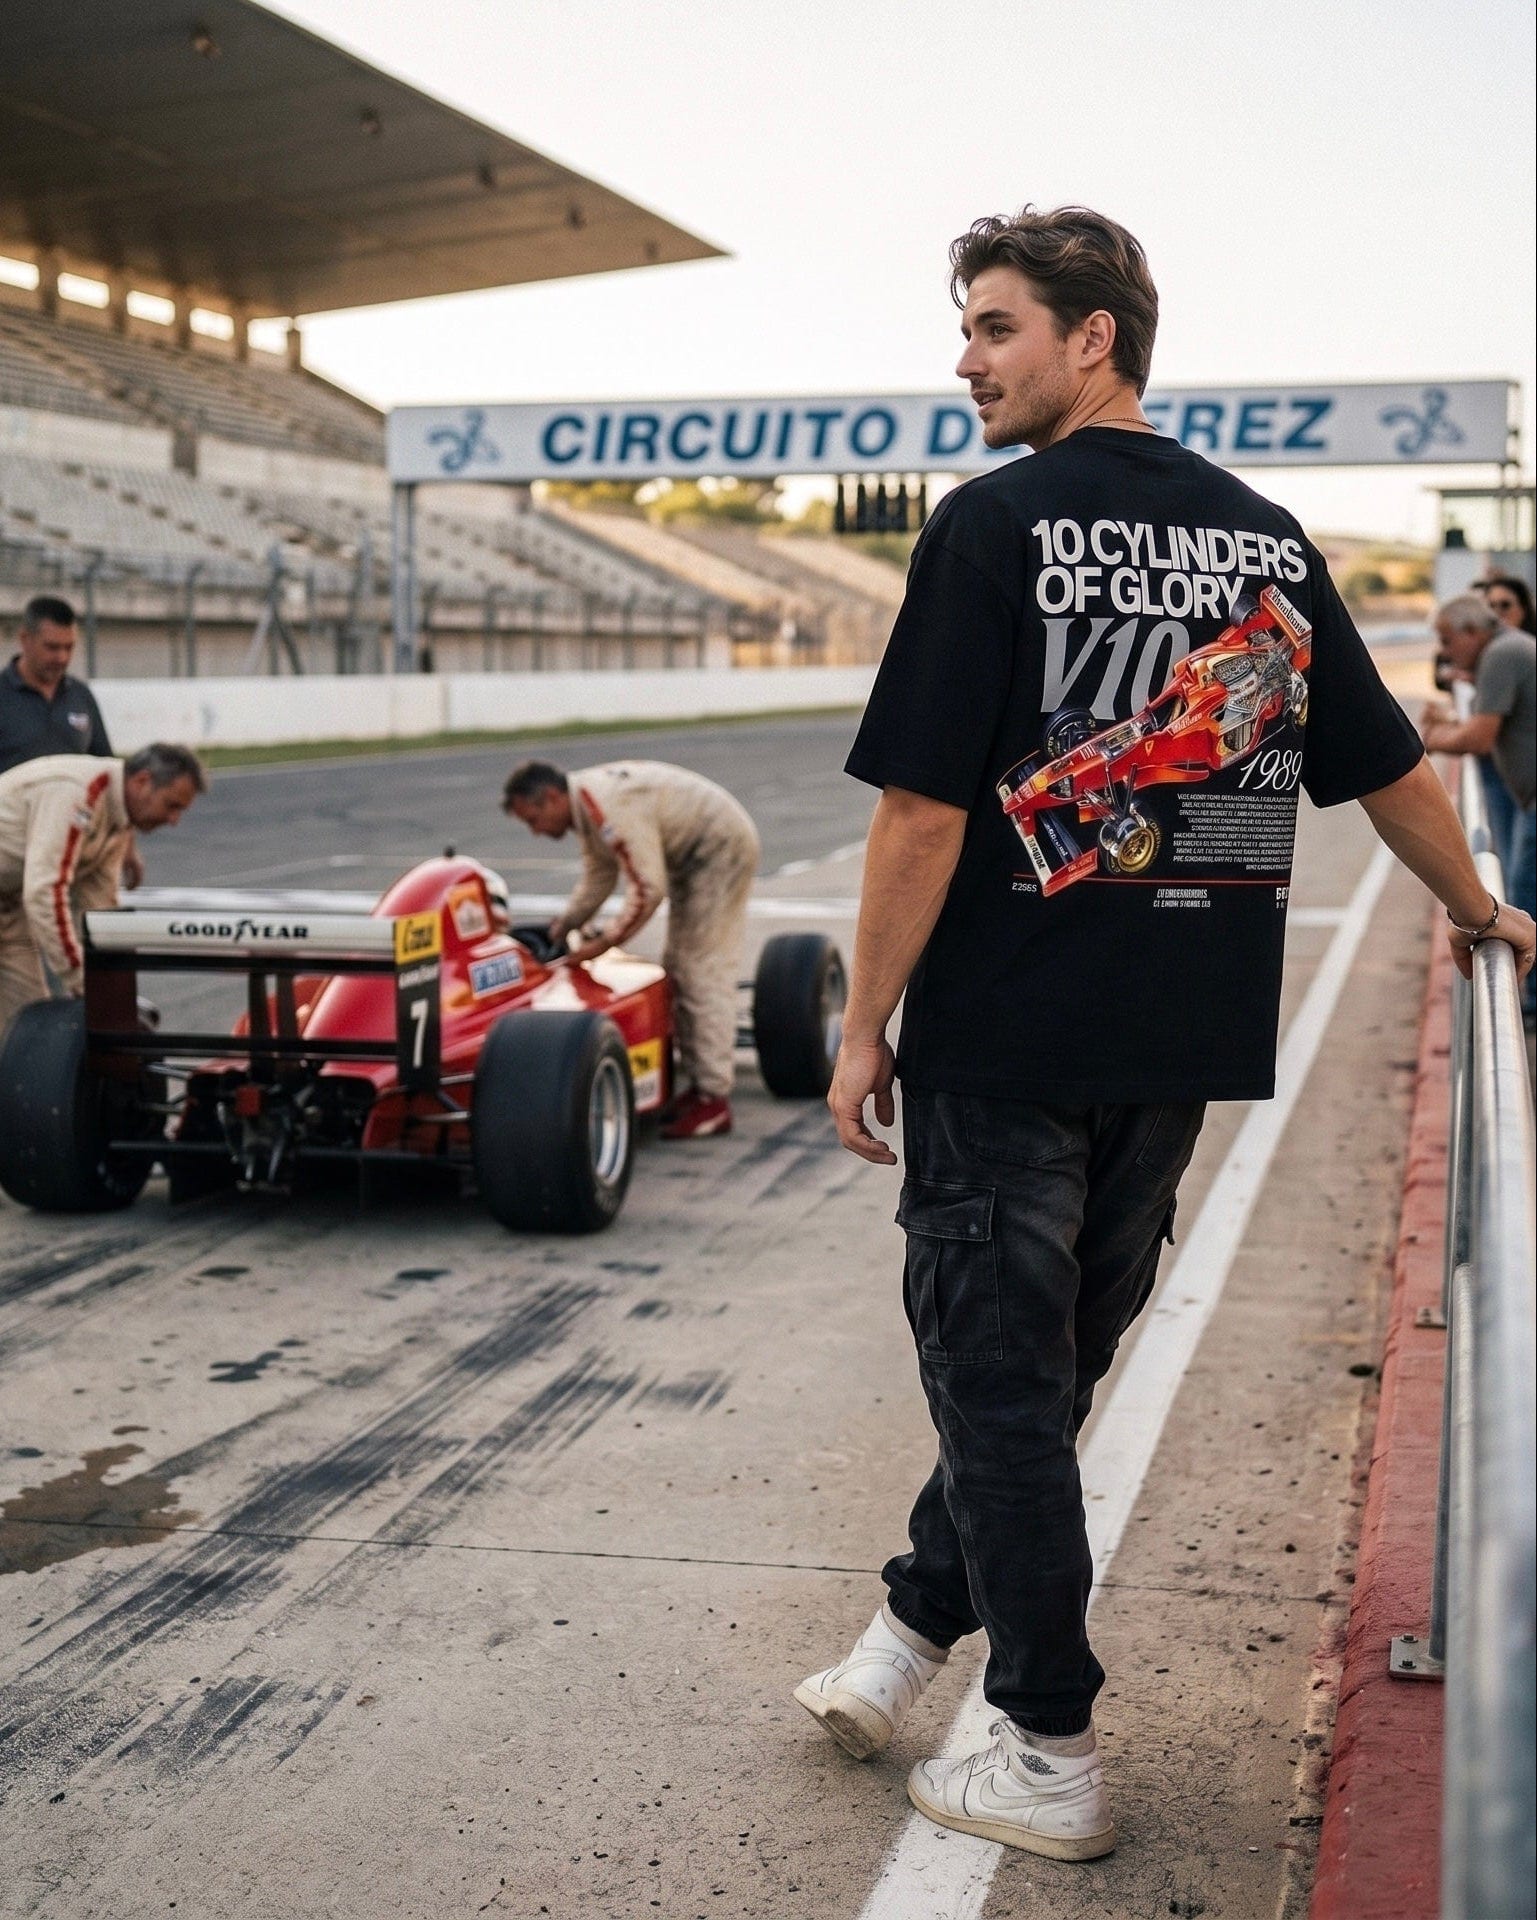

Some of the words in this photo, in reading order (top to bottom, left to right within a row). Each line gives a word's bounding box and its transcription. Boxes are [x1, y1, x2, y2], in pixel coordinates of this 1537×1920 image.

[542, 407, 896, 464] CIRCUITO
[1031, 519, 1085, 565] 10
[1090, 519, 1308, 583] CYLINDERS
[1036, 566, 1102, 614] OF
[1110, 568, 1245, 619] GLORY
[1040, 617, 1191, 721] V10
[1238, 749, 1303, 791] 1989
